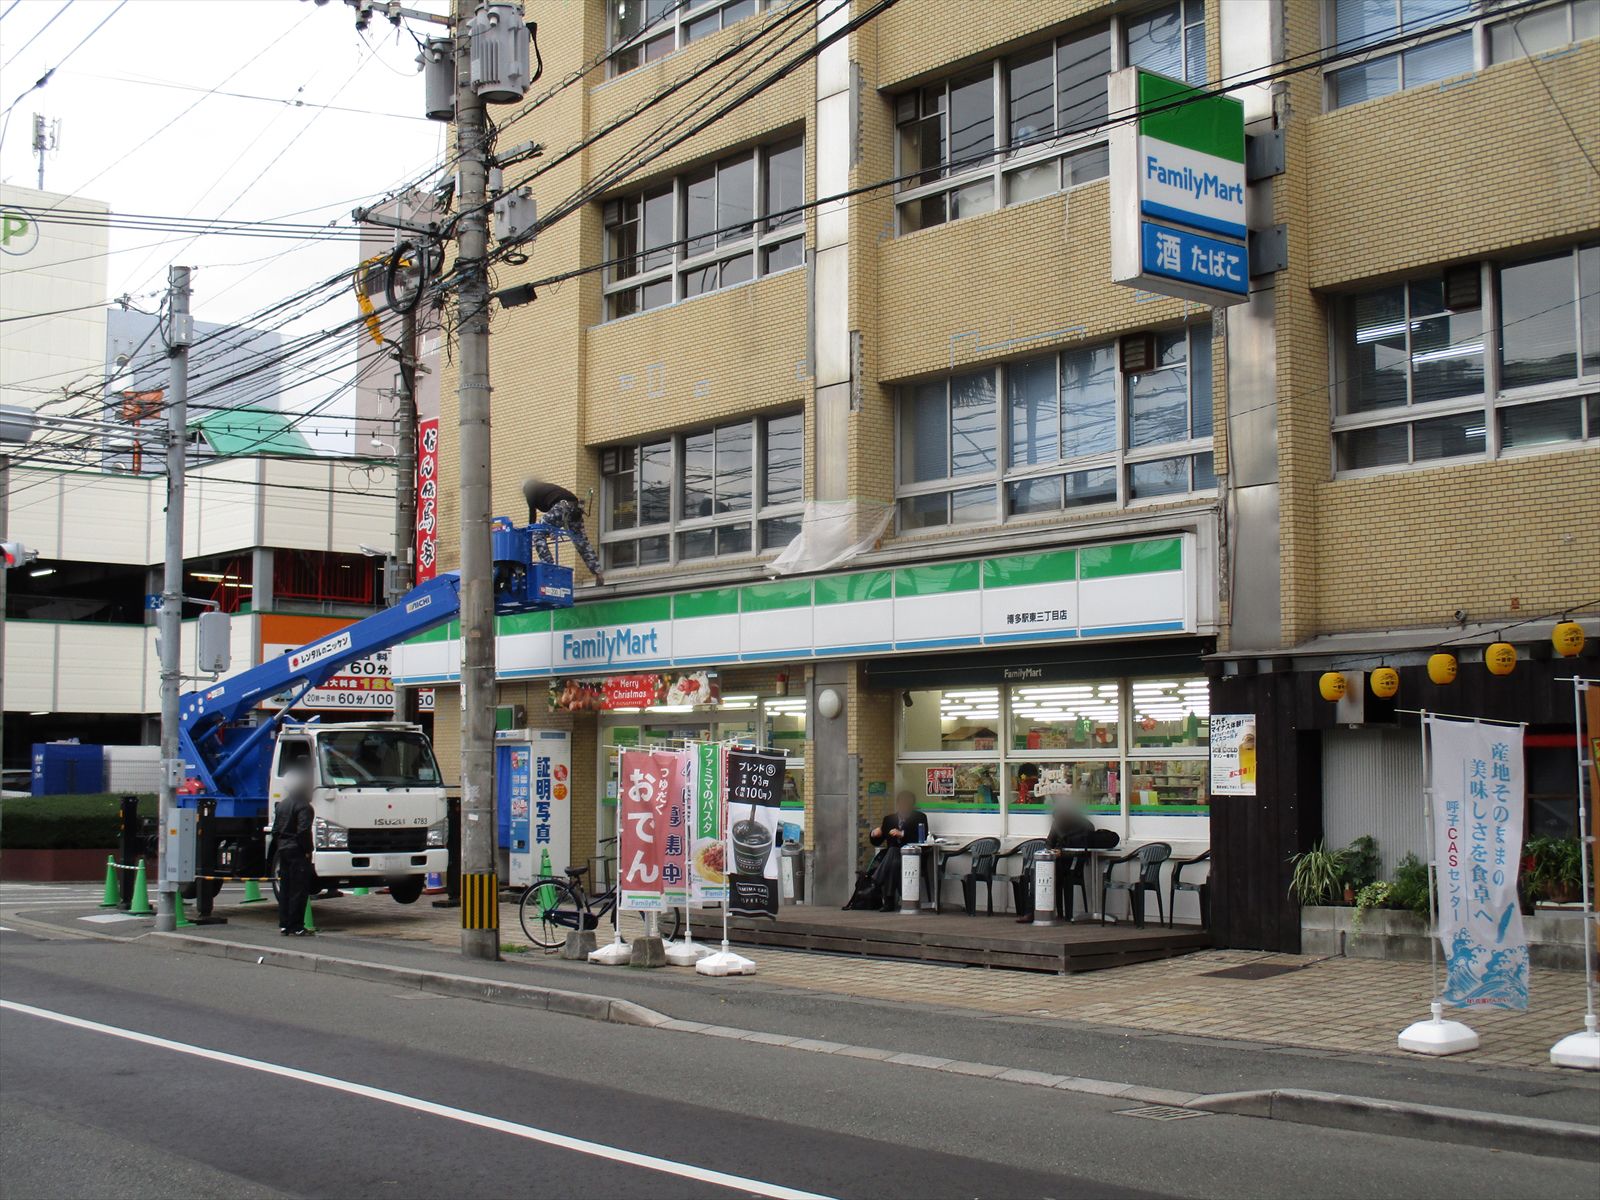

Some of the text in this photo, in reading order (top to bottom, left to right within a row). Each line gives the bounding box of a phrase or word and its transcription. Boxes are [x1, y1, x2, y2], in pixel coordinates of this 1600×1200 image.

[1147, 156, 1243, 205] FamilyMart
[1156, 232, 1241, 281] 酒 たばこ
[1007, 610, 1067, 624] 博多駅東三丁目店
[301, 637, 349, 664] レンタルのニッケン
[563, 627, 658, 664] FamilyMart
[620, 679, 639, 689] Merry
[1004, 668, 1042, 679] FamilyMart
[613, 690, 647, 700] Christmas
[739, 762, 765, 772] ブレンド
[752, 774, 769, 787] 93円
[536, 757, 551, 845] 証明写真
[655, 768, 669, 815] つゆだく
[703, 748, 713, 833] ファミマのパスタ
[413, 817, 428, 825] 4783
[626, 769, 659, 884] おでん
[1491, 742, 1511, 886] 産地そのままの
[1470, 758, 1493, 923] 美味しさを食卓へ
